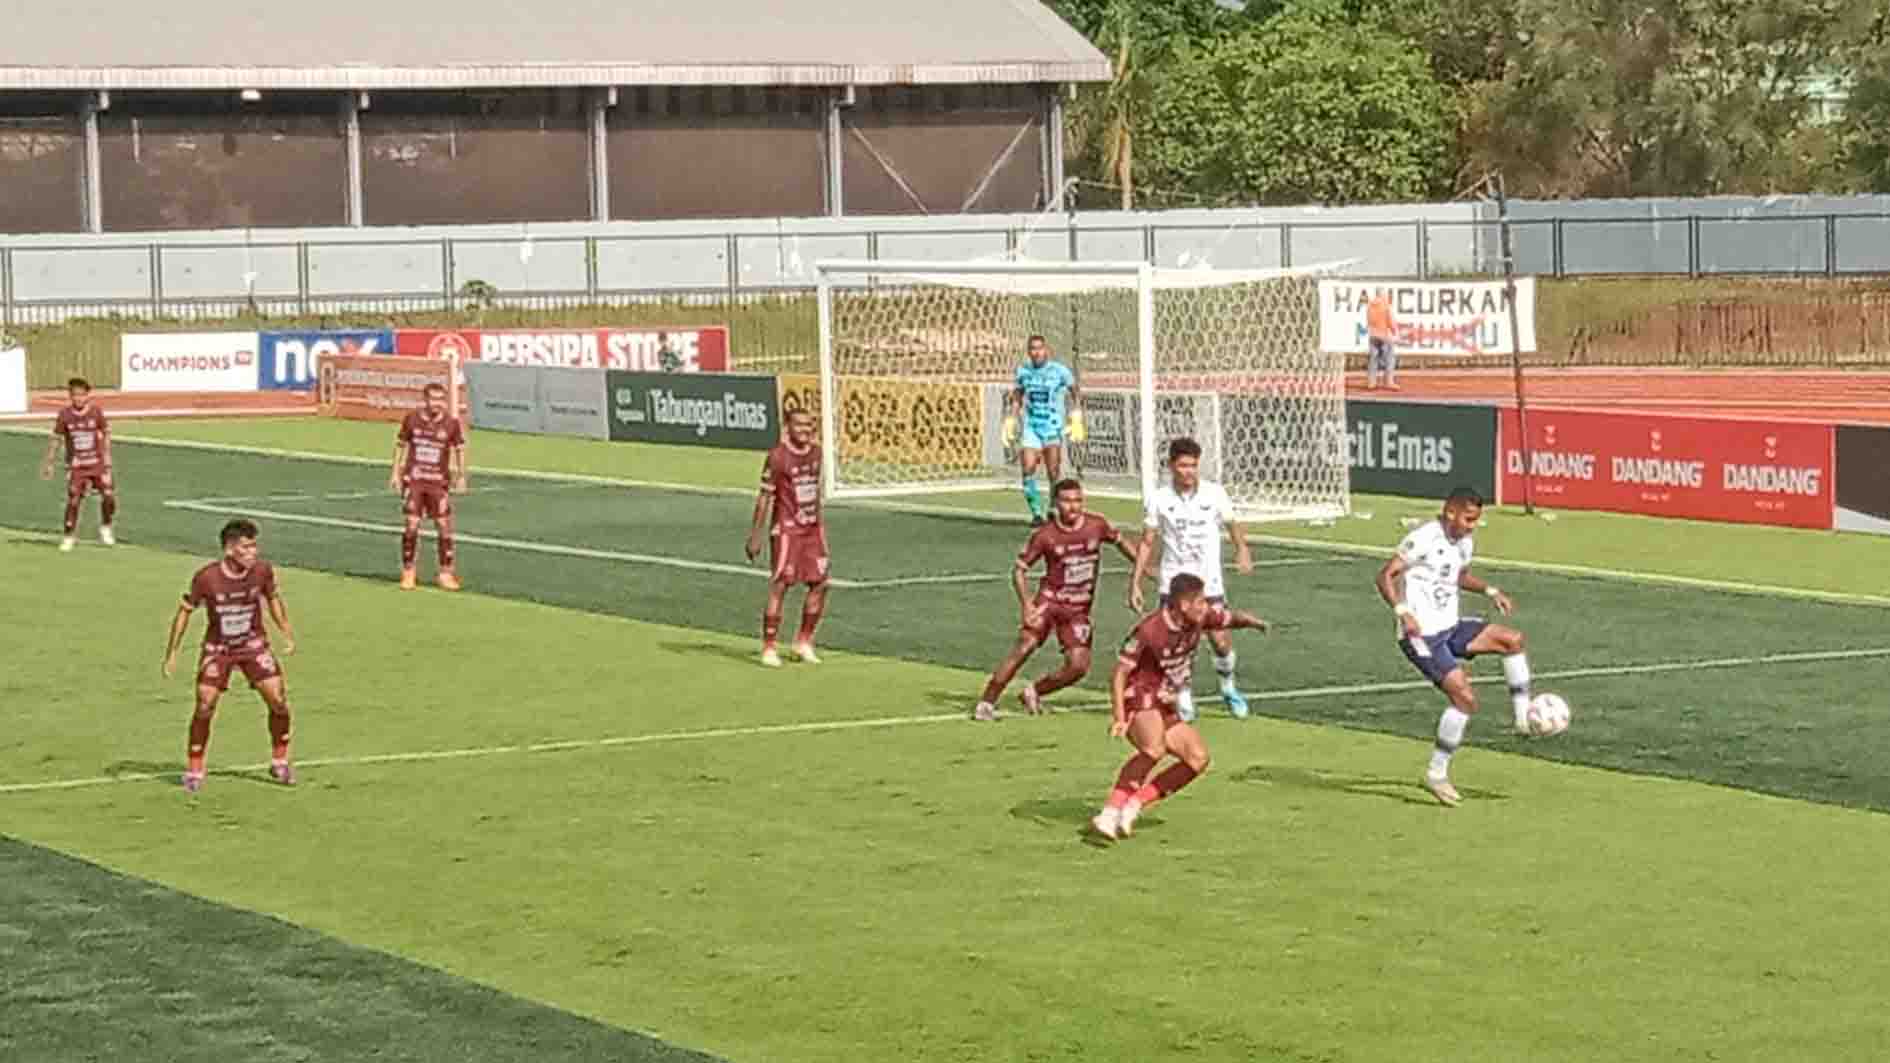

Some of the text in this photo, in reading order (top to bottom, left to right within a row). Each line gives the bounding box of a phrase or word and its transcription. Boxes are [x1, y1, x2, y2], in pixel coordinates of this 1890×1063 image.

[128, 352, 232, 373] CHAMPIONS
[481, 333, 600, 367] PERSIPA
[650, 387, 724, 436] Tabungan
[724, 391, 767, 431] Emas
[1381, 423, 1453, 475] Emas
[1611, 455, 1705, 489] DANDANG
[1722, 462, 1822, 496] DANDANG
